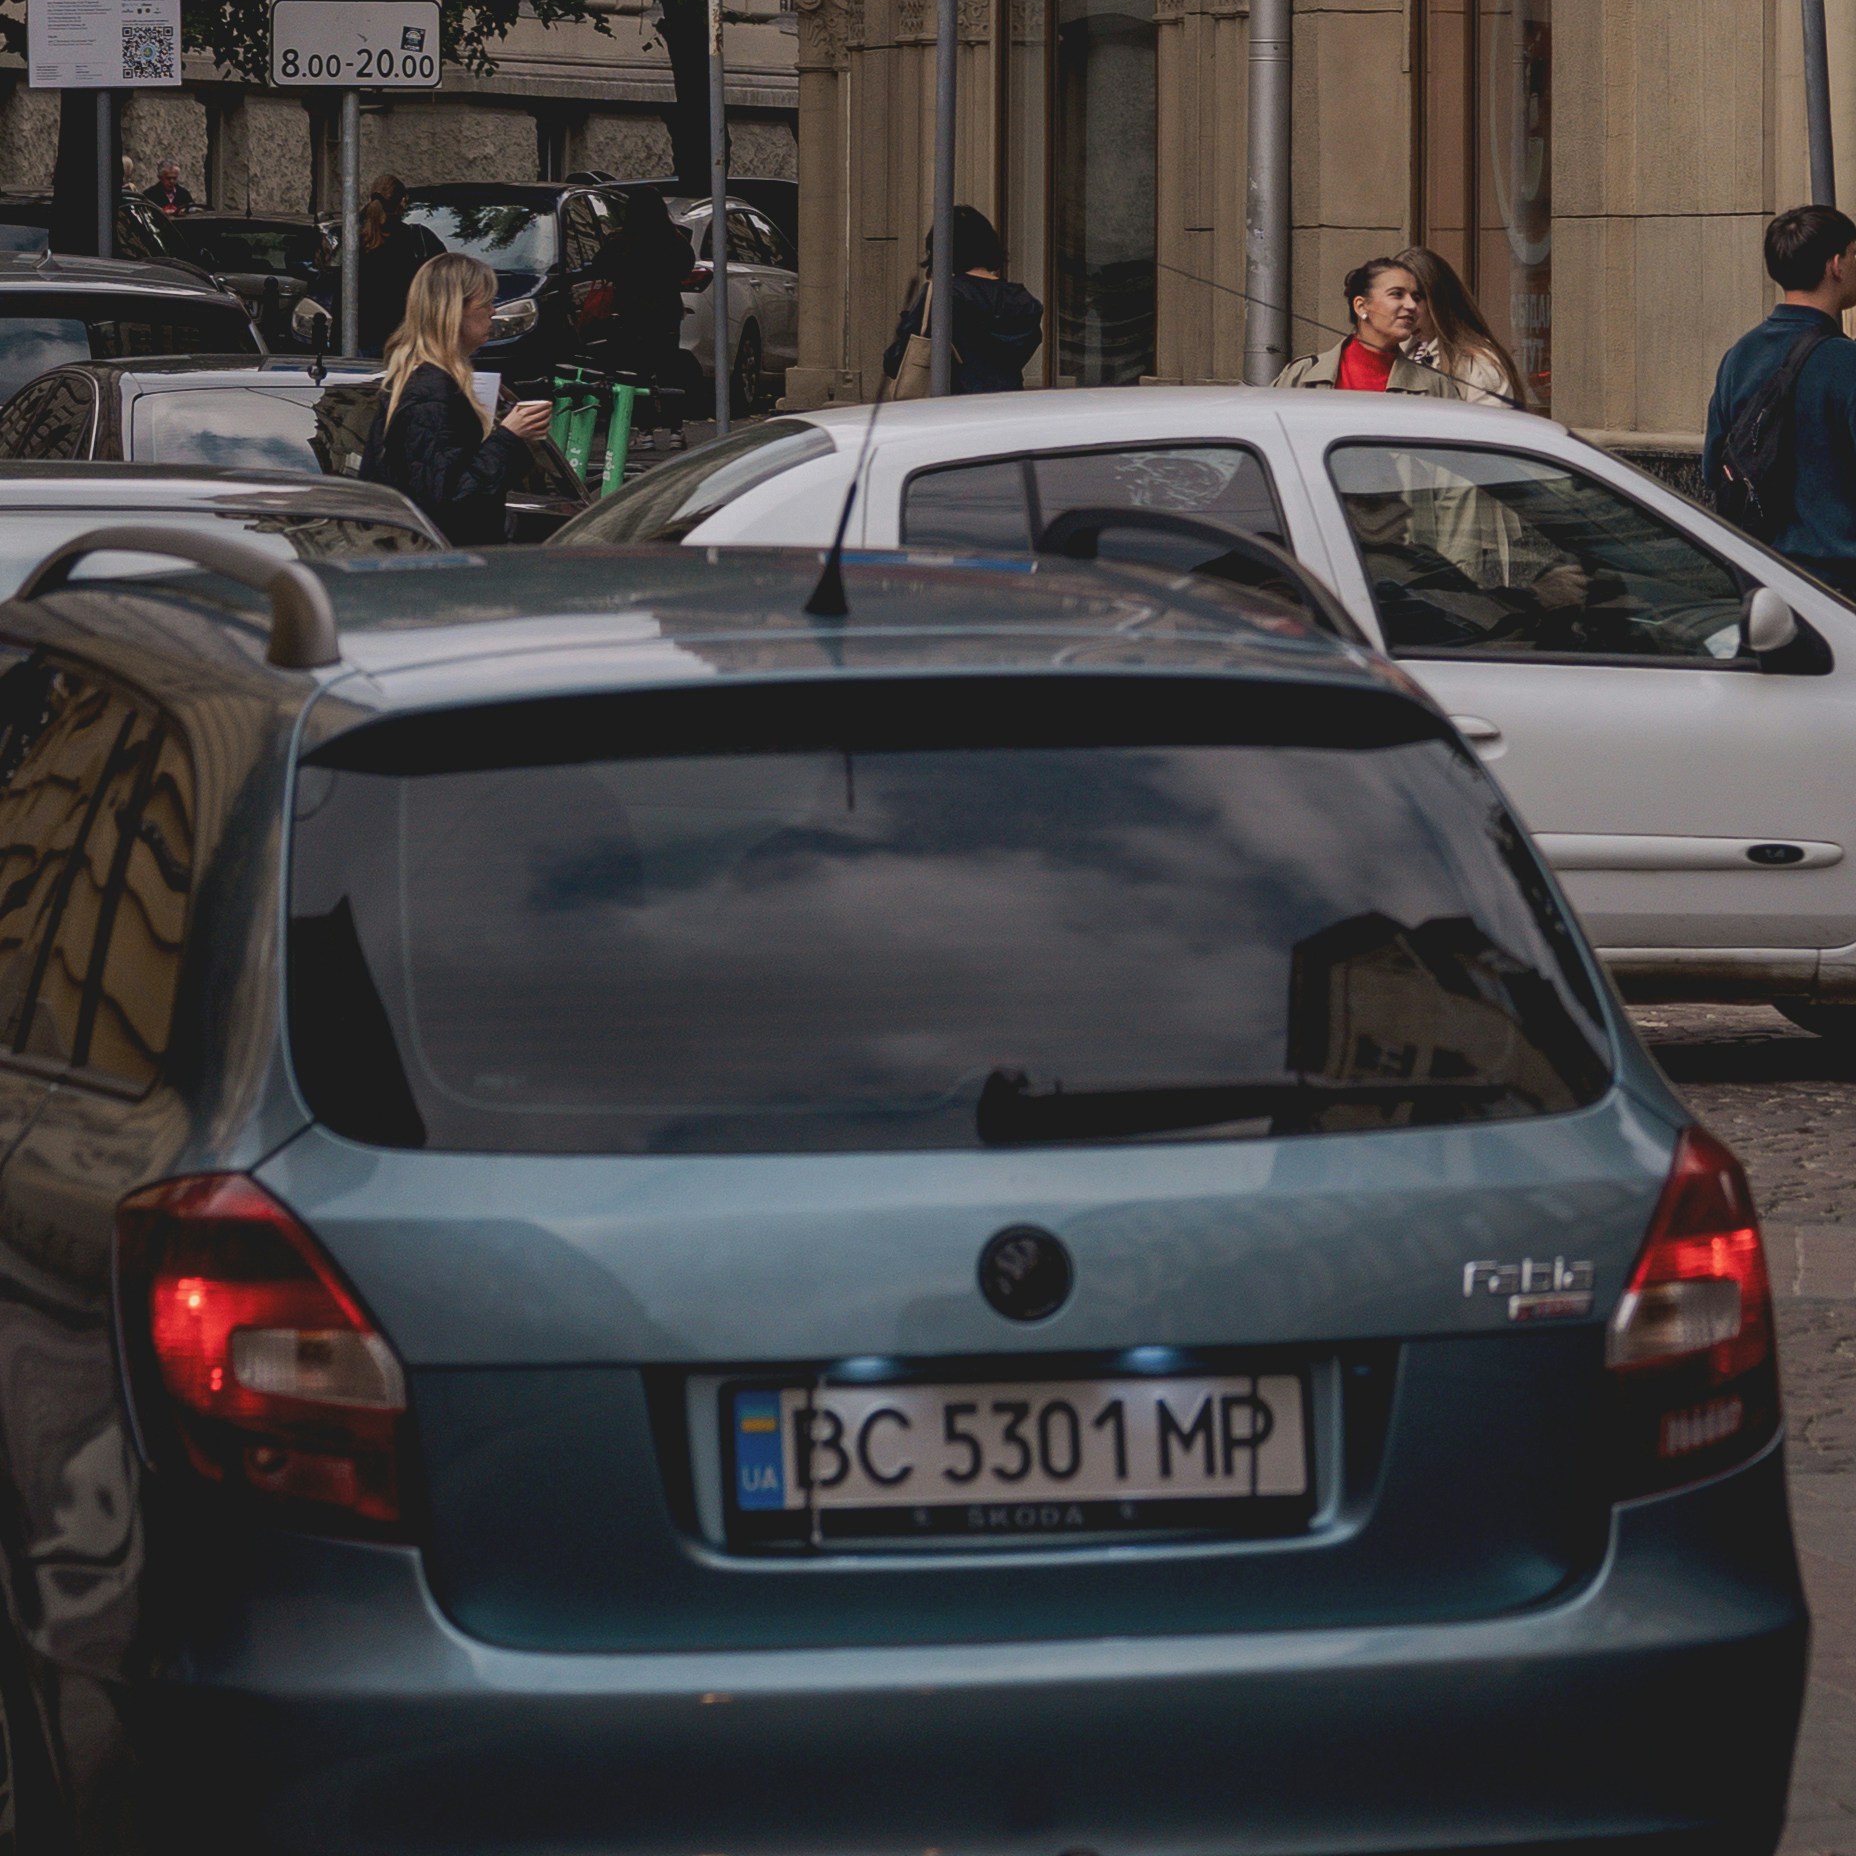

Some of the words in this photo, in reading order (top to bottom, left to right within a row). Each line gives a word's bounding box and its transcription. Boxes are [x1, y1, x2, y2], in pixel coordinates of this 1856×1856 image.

[943, 1396, 1131, 1487] 5301
[1158, 1391, 1275, 1479] MP
[743, 1466, 779, 1494] UA
